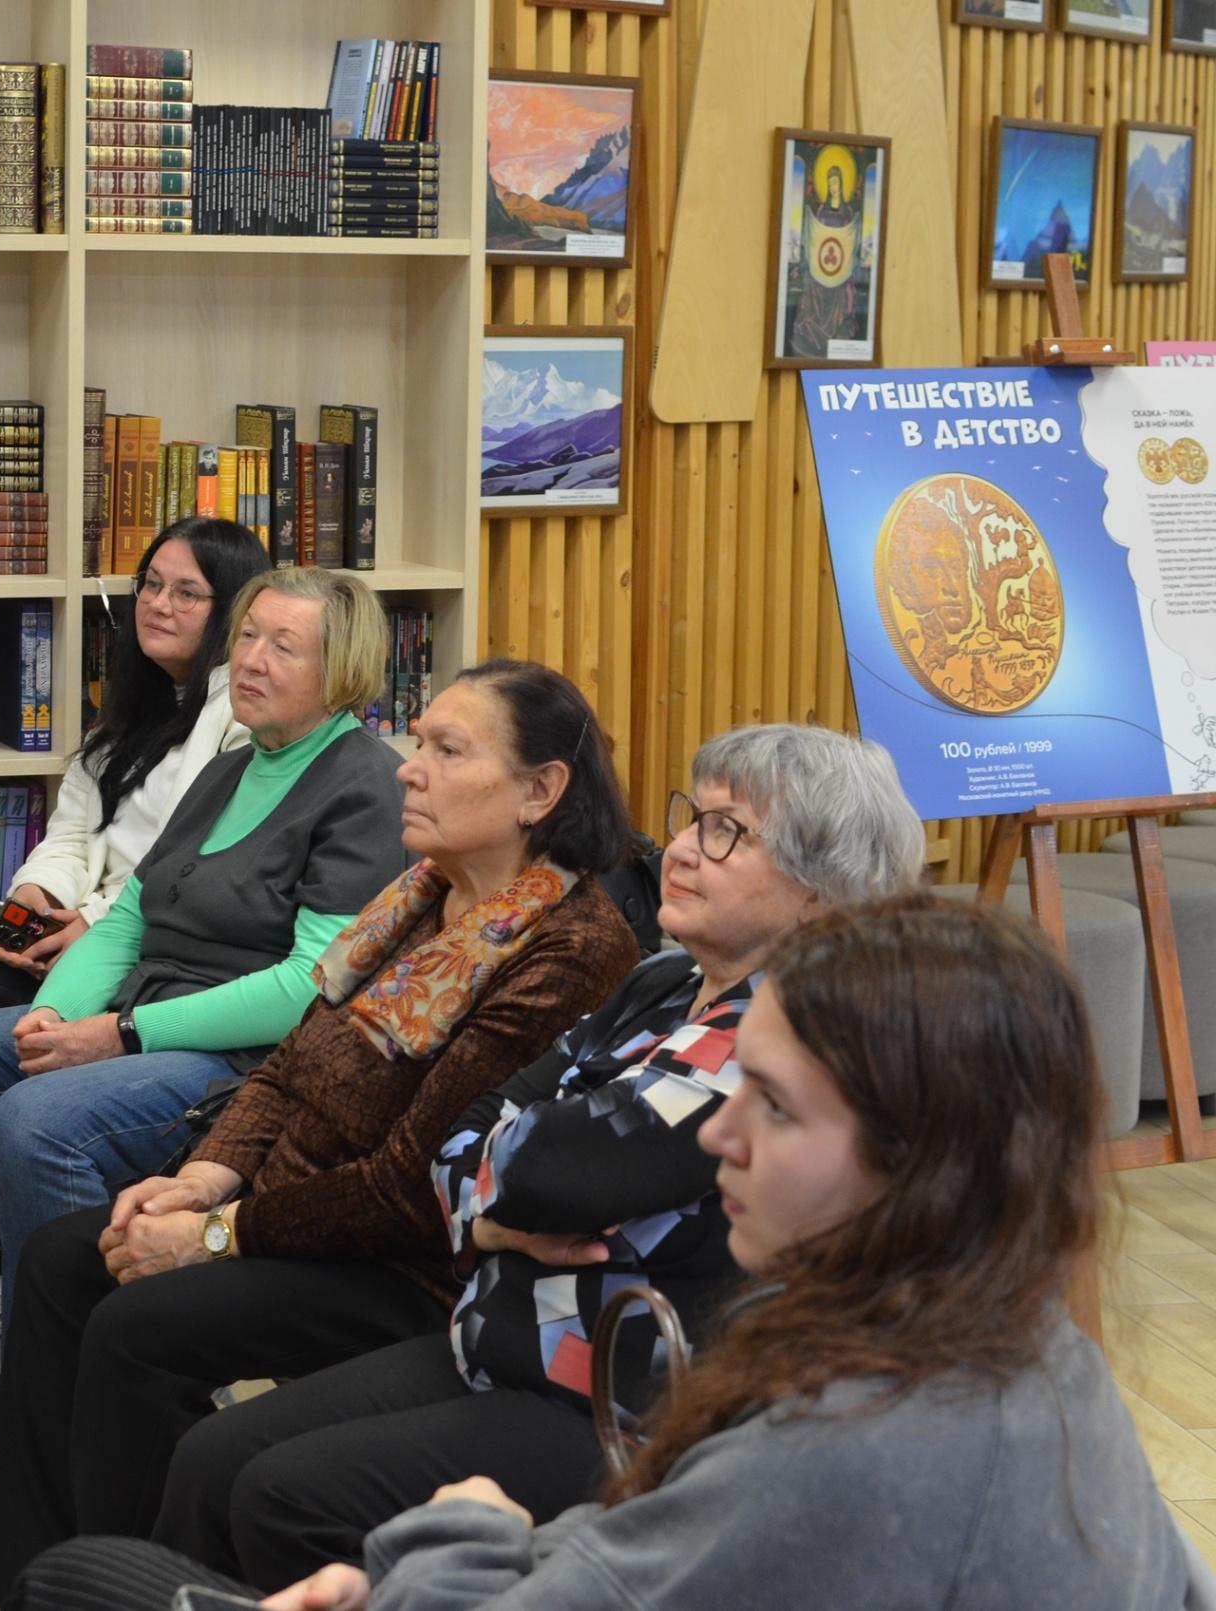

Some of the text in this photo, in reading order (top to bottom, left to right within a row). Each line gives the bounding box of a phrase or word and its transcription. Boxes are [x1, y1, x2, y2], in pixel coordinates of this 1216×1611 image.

[416, 47, 428, 74] AIRPORT
[818, 379, 1034, 412] ПУТЕШЕСТВИЕ
[901, 417, 1063, 451] В ДЕТСТВО
[939, 742, 972, 758] 100
[974, 742, 1016, 758] рублей
[1023, 740, 1052, 753] 1999
